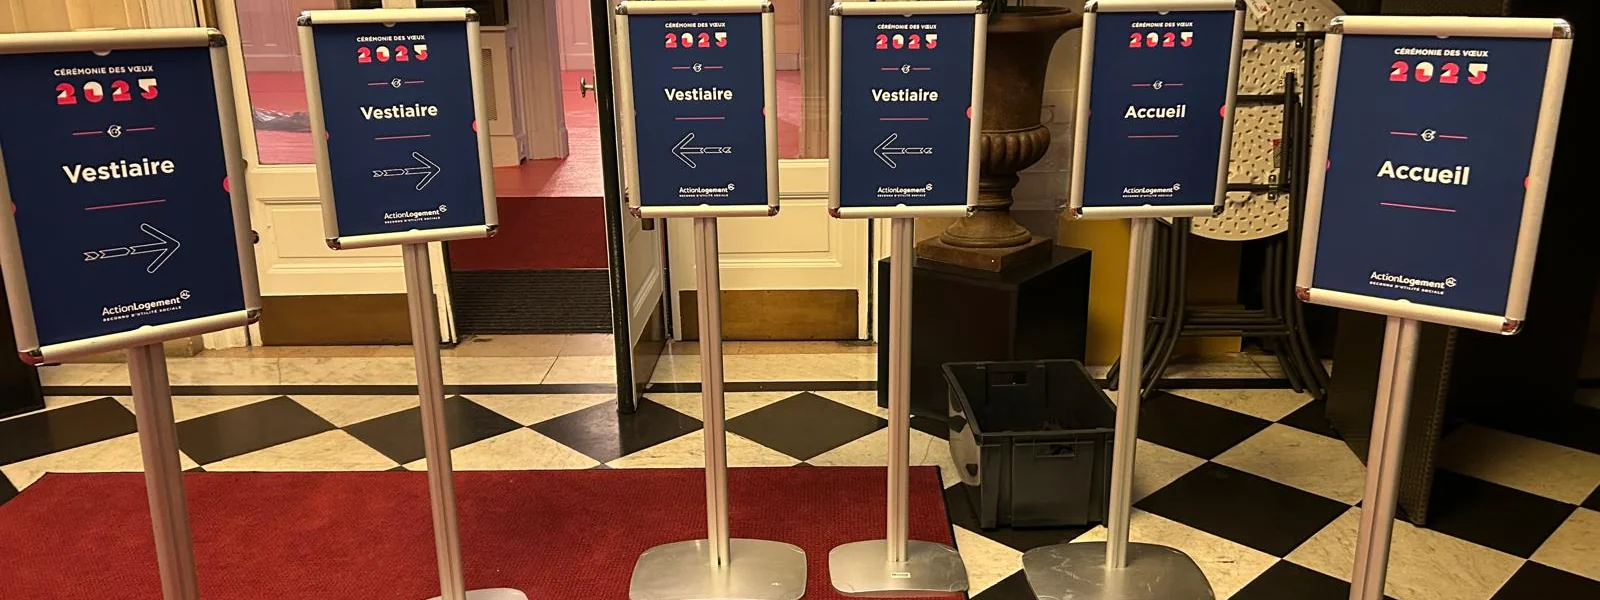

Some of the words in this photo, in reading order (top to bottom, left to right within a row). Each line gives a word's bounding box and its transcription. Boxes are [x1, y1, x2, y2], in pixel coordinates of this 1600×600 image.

[356, 35, 392, 43] CÉRÉMONIE
[665, 32, 728, 48] 2025
[876, 33, 938, 49] 2025
[1129, 31, 1194, 48] 2025
[357, 44, 428, 63] 2025
[1394, 48, 1442, 56] CÉRÉMONIE
[1443, 49, 1461, 57] DES
[1462, 50, 1489, 58] VŒUX
[53, 66, 107, 76] CÉRÉMONIE
[127, 65, 154, 73] VŒUX
[1389, 60, 1489, 85] 2025
[55, 78, 159, 105] 2025
[664, 87, 733, 101] Vestiaire
[871, 88, 939, 102] Vestiaire
[360, 103, 438, 120] Vestiaire
[1124, 104, 1186, 119] Accueil
[62, 158, 175, 184] Vestiaire
[1376, 160, 1470, 186] Accueil
[679, 186, 728, 194] ActionLogement
[1123, 187, 1173, 195] ActionLogement
[384, 209, 440, 220] ActionLogement
[1370, 271, 1445, 289] ActionLogement
[102, 296, 181, 316] ActionLogement
